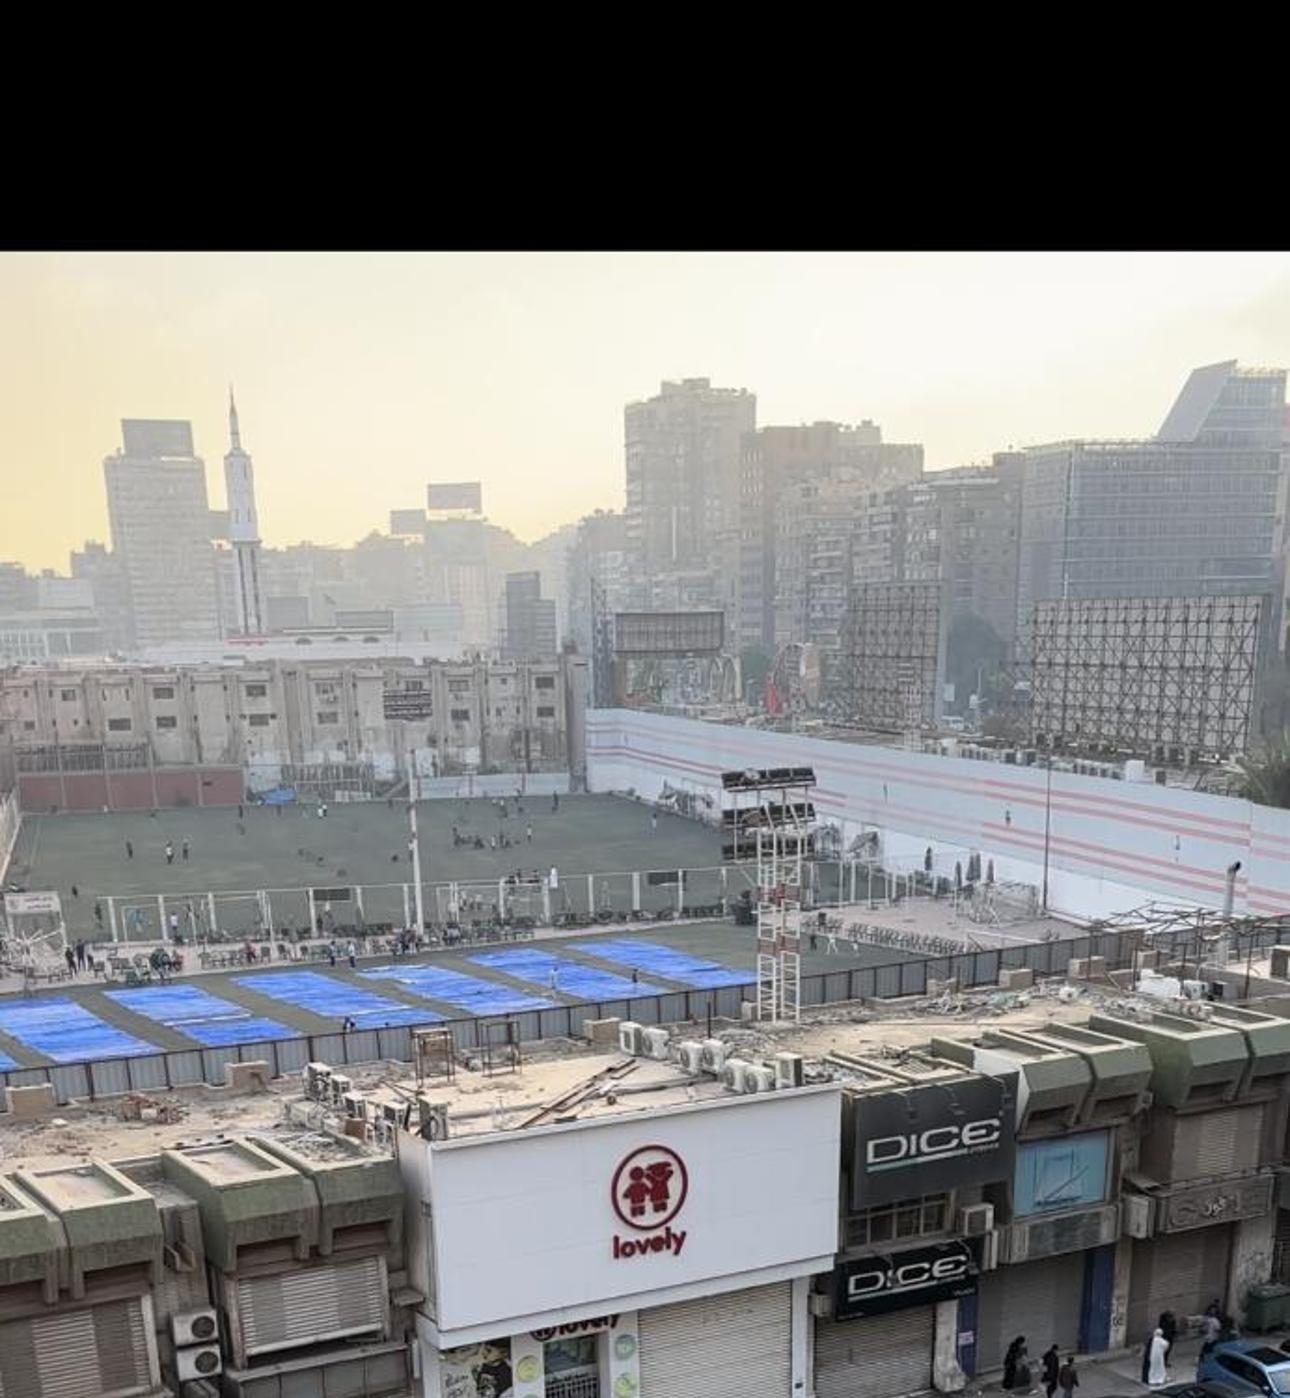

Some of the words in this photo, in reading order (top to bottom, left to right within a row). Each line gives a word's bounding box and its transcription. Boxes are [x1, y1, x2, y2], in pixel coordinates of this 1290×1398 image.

[866, 1118, 1000, 1164] DICE
[613, 1226, 687, 1260] lovely
[848, 1254, 968, 1295] DICE
